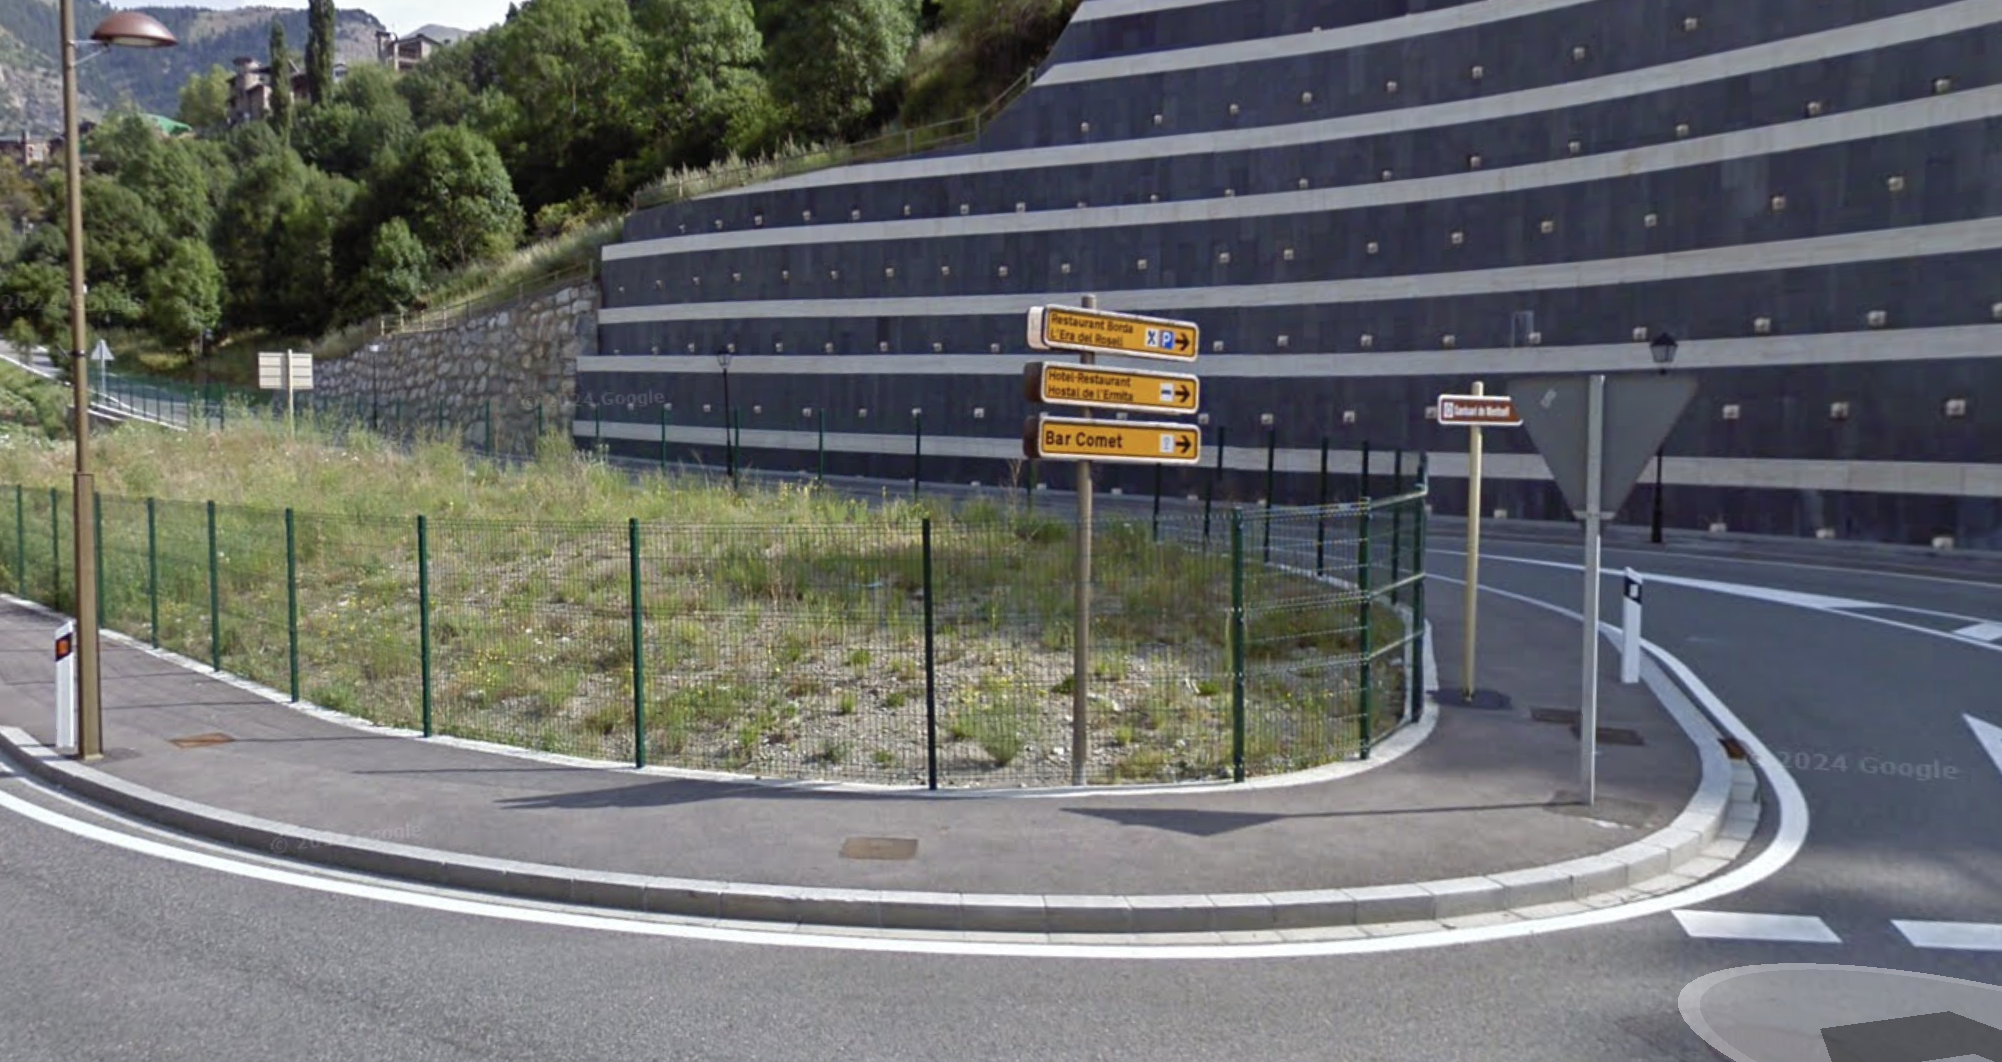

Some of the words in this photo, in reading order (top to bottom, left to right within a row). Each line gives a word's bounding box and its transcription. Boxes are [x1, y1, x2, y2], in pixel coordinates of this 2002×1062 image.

[1052, 313, 1105, 330] Restaurant
[1107, 322, 1133, 333] Borda
[1051, 328, 1075, 341] L'Era
[1077, 332, 1093, 344] del
[1049, 370, 1131, 387] Hotel-Restaurant
[1048, 386, 1080, 398] Hostal
[1082, 387, 1094, 398] de
[1045, 430, 1071, 445] Bar
[1075, 431, 1123, 448] Comet
